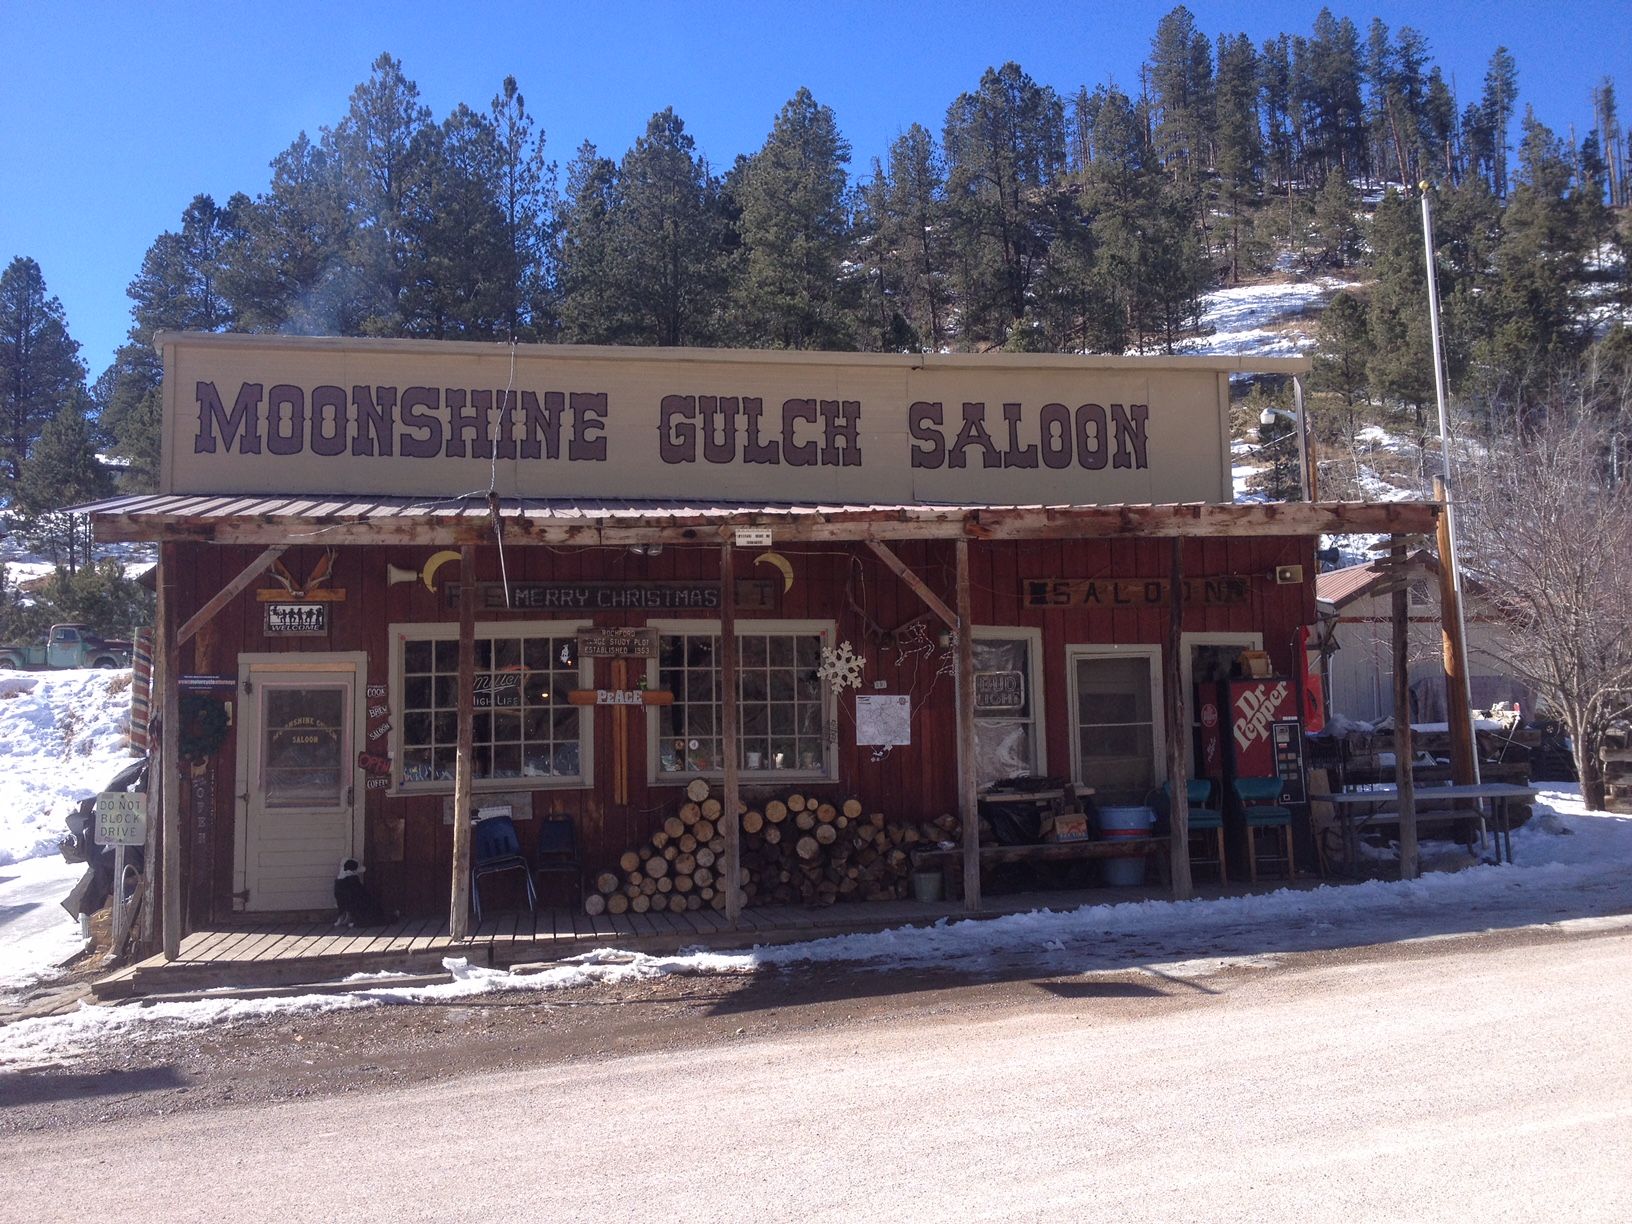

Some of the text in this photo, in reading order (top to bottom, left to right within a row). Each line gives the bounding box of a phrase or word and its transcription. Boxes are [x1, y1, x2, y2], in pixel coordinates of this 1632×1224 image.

[194, 381, 1149, 470] MOONSHINE GULCH SALOON
[515, 588, 589, 606] MERRY
[598, 589, 717, 607] CHRISTMAS
[601, 629, 636, 637] ROCHFORD
[609, 638, 630, 646] STUDY
[633, 638, 650, 646] PLOT
[584, 646, 628, 654] ESTABLISHED
[978, 676, 1016, 692] BUD
[497, 695, 519, 706] LIFE
[1235, 683, 1267, 720] Dr
[1233, 681, 1288, 752] Pepper
[292, 735, 319, 744] SALOON
[358, 753, 392, 775] OPEN
[100, 800, 141, 811] DO NOT
[101, 813, 140, 824] BLOCK
[100, 826, 137, 837] DRIVE
